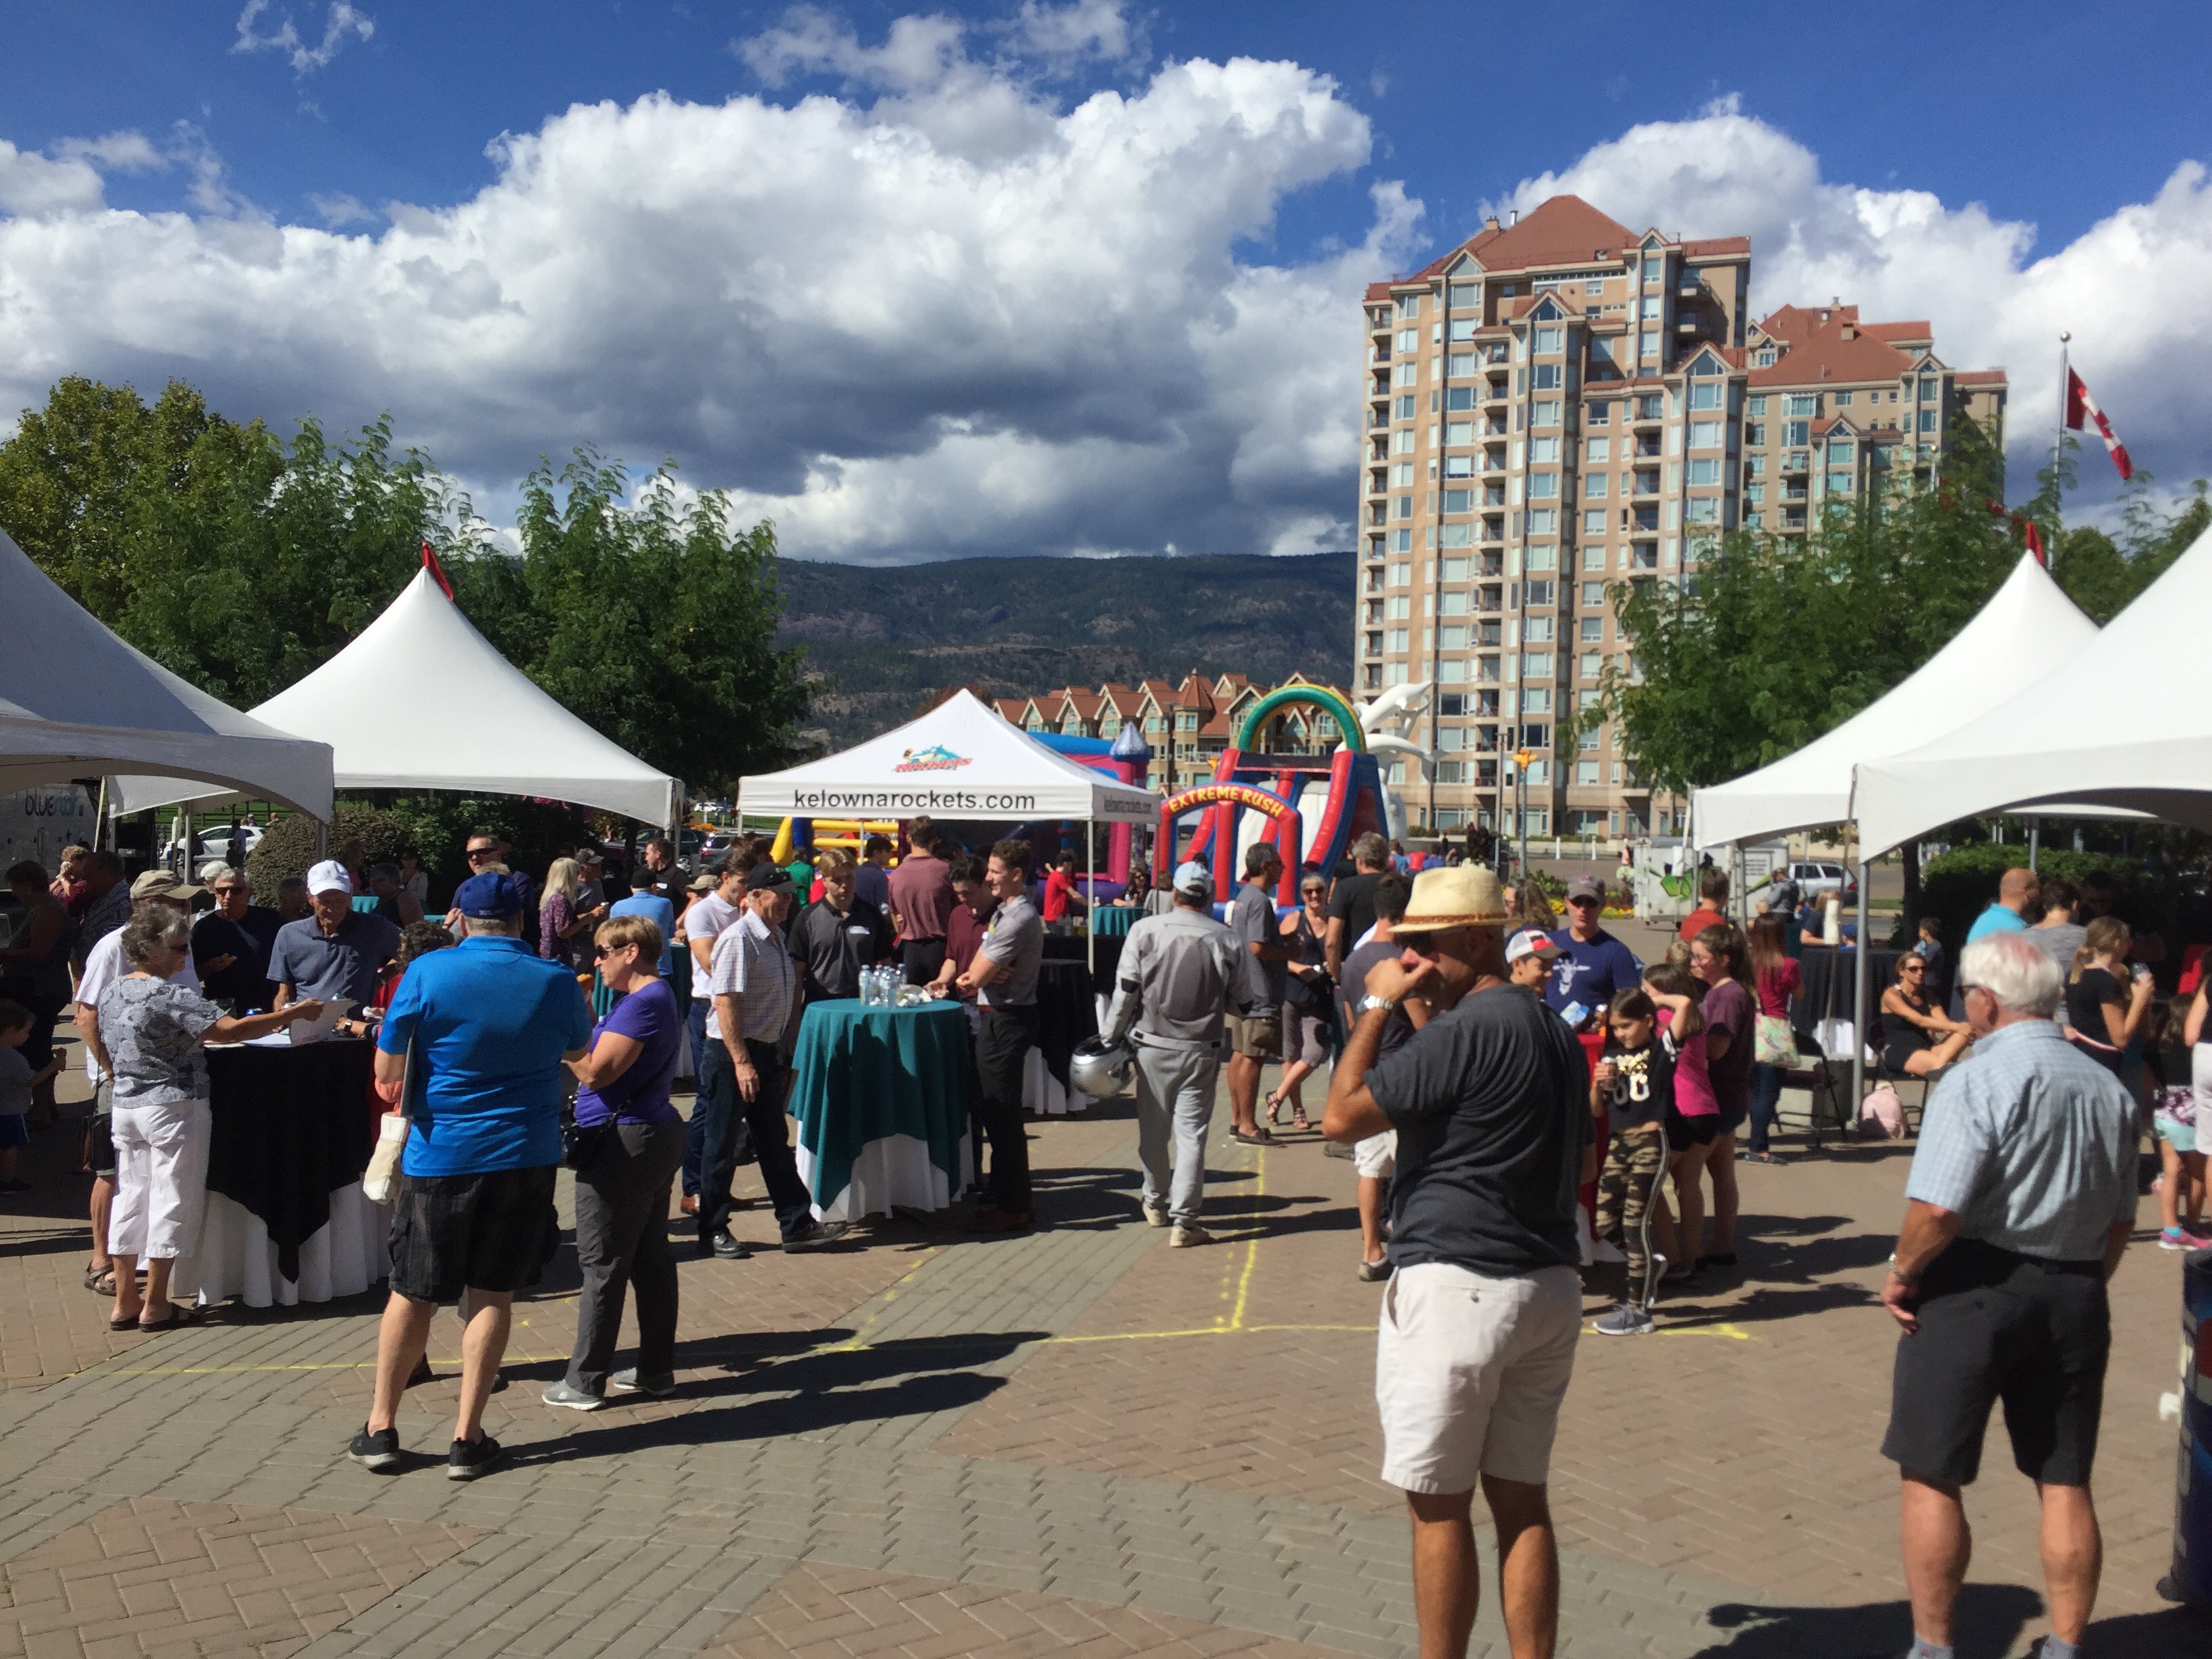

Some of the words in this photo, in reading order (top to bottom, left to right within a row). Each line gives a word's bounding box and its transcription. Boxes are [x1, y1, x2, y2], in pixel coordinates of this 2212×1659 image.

[794, 790, 1036, 810] kelownarockets.com
[1168, 785, 1240, 813] EXTREME
[1241, 788, 1285, 818] RUSH
